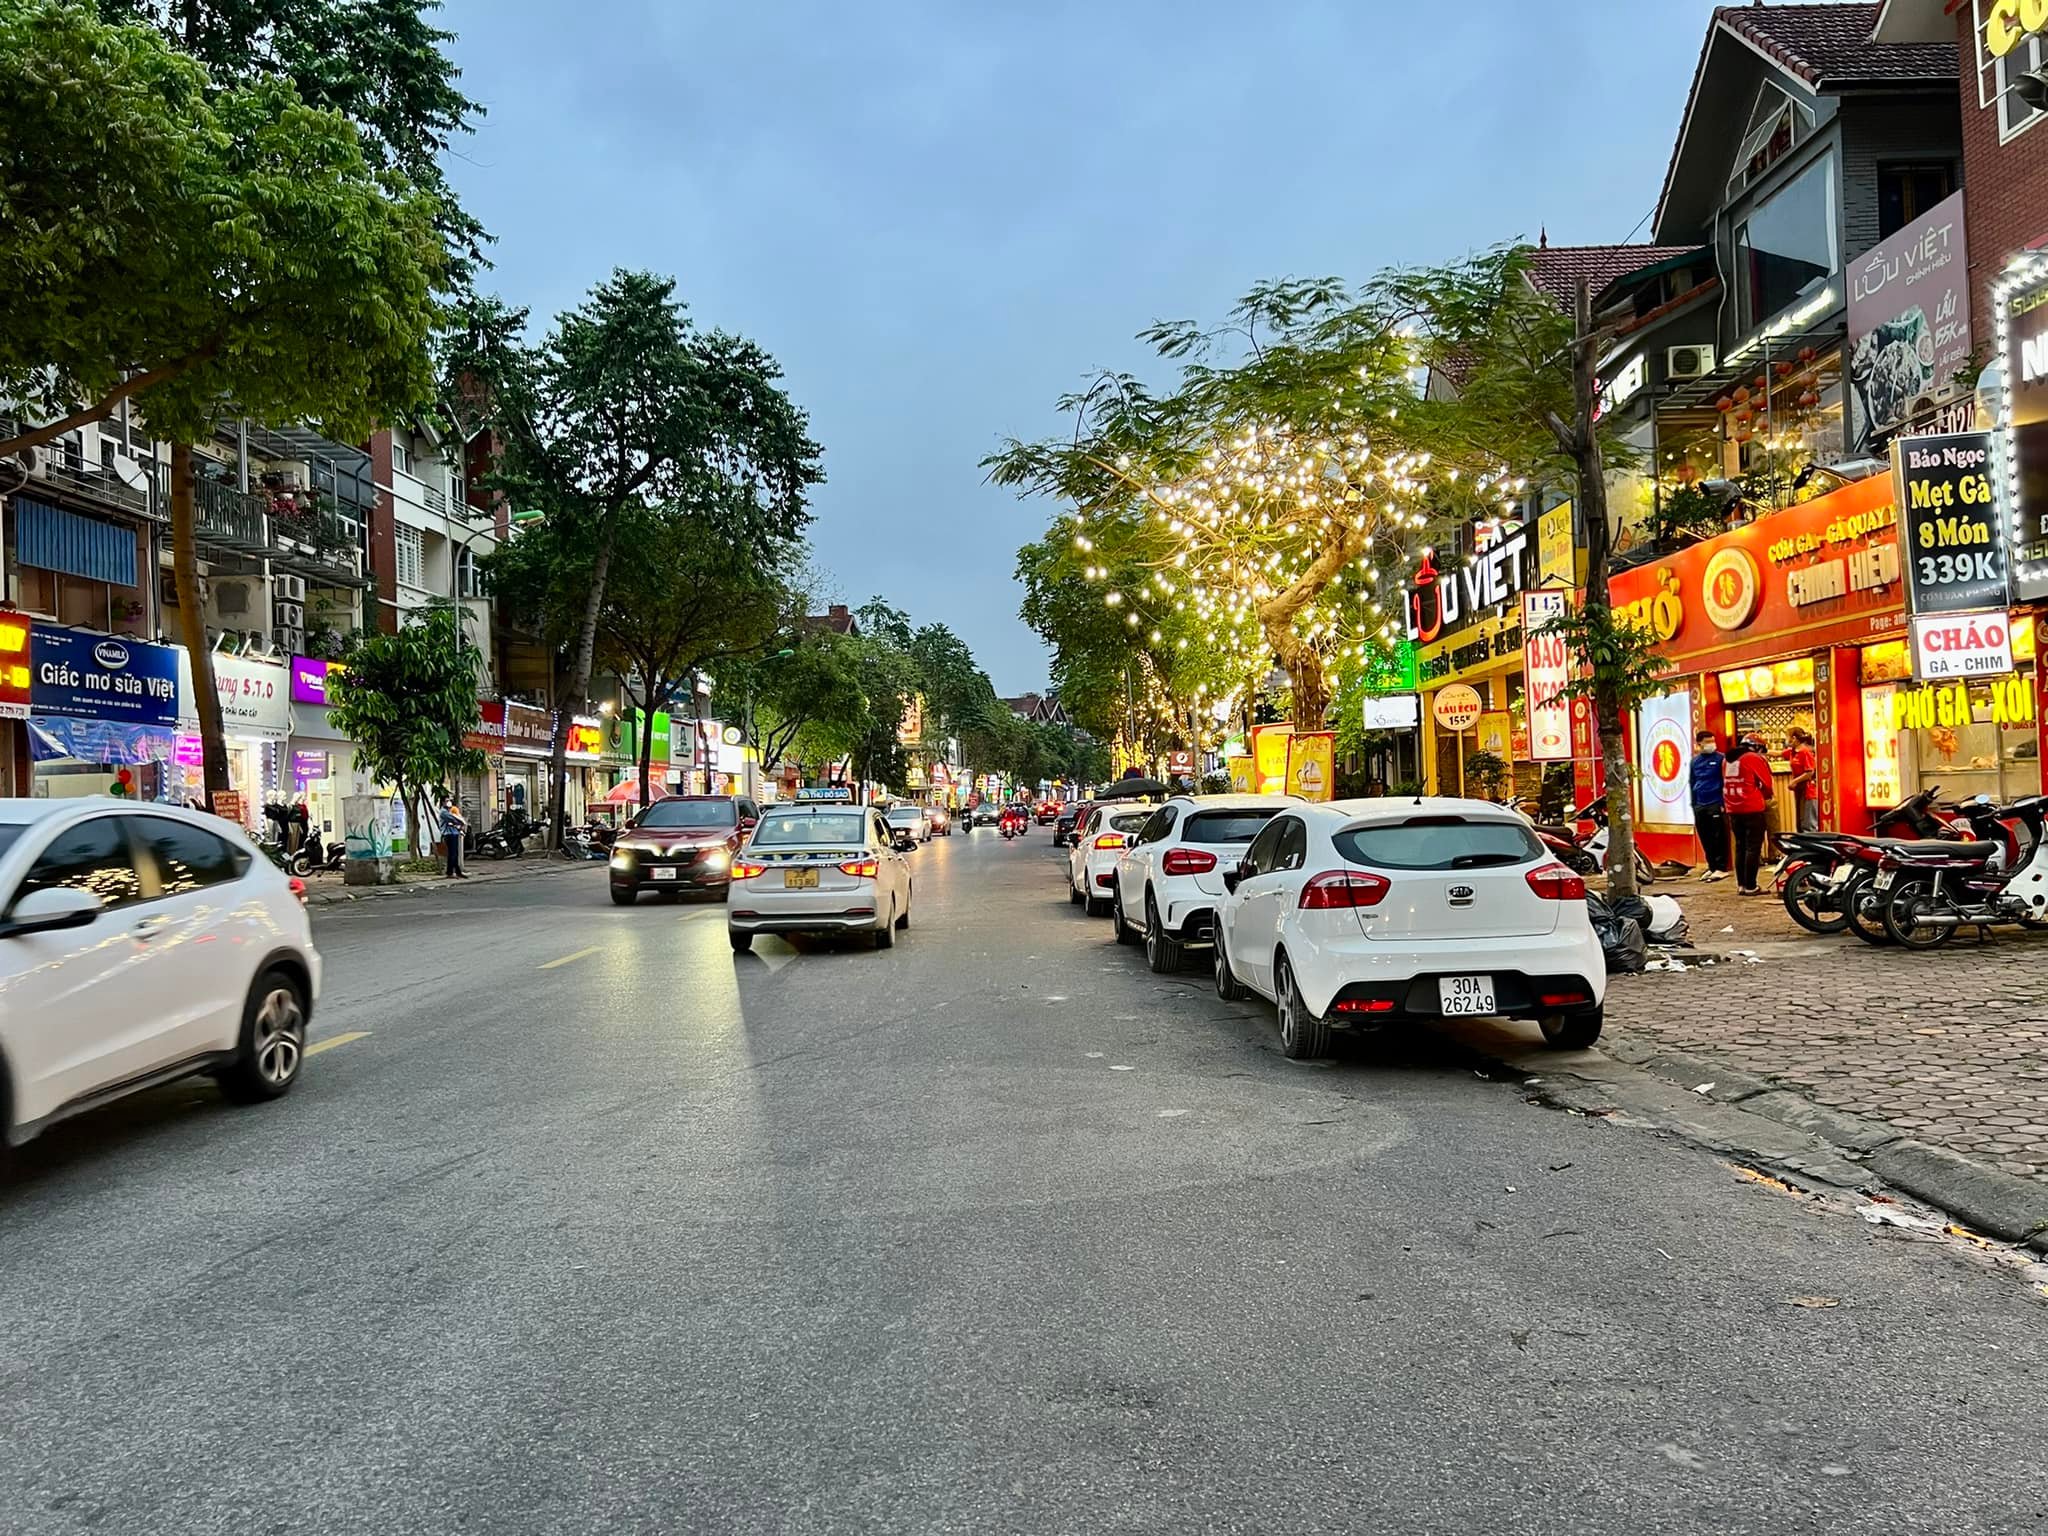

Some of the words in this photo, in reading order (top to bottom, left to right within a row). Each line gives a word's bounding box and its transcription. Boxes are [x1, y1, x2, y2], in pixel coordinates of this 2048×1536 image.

[1908, 448, 1941, 469] Bảo
[1942, 447, 1986, 469] Ngọc
[1909, 479, 1954, 515] Mẹt
[1959, 473, 1992, 504] Gà
[1847, 504, 1887, 539] QUAY
[1919, 521, 1935, 548] 8
[1936, 515, 1990, 547] Món
[1918, 551, 1998, 586] 339K
[1923, 620, 2005, 653] CHÁO
[1929, 657, 1950, 674] GÀ
[1964, 656, 2004, 671] CHIM
[40, 660, 80, 687] Giấc
[85, 671, 111, 692] mơ
[114, 673, 143, 696] sữa
[146, 676, 175, 703] Việt
[242, 677, 274, 700] S.T.O
[1892, 680, 1937, 731] PHỞ
[1937, 678, 1973, 727] GÀ
[1448, 714, 1471, 726] 155K
[1451, 886, 1472, 898] KIA
[1452, 977, 1482, 995] 30A
[1443, 995, 1494, 1013] 262.49
